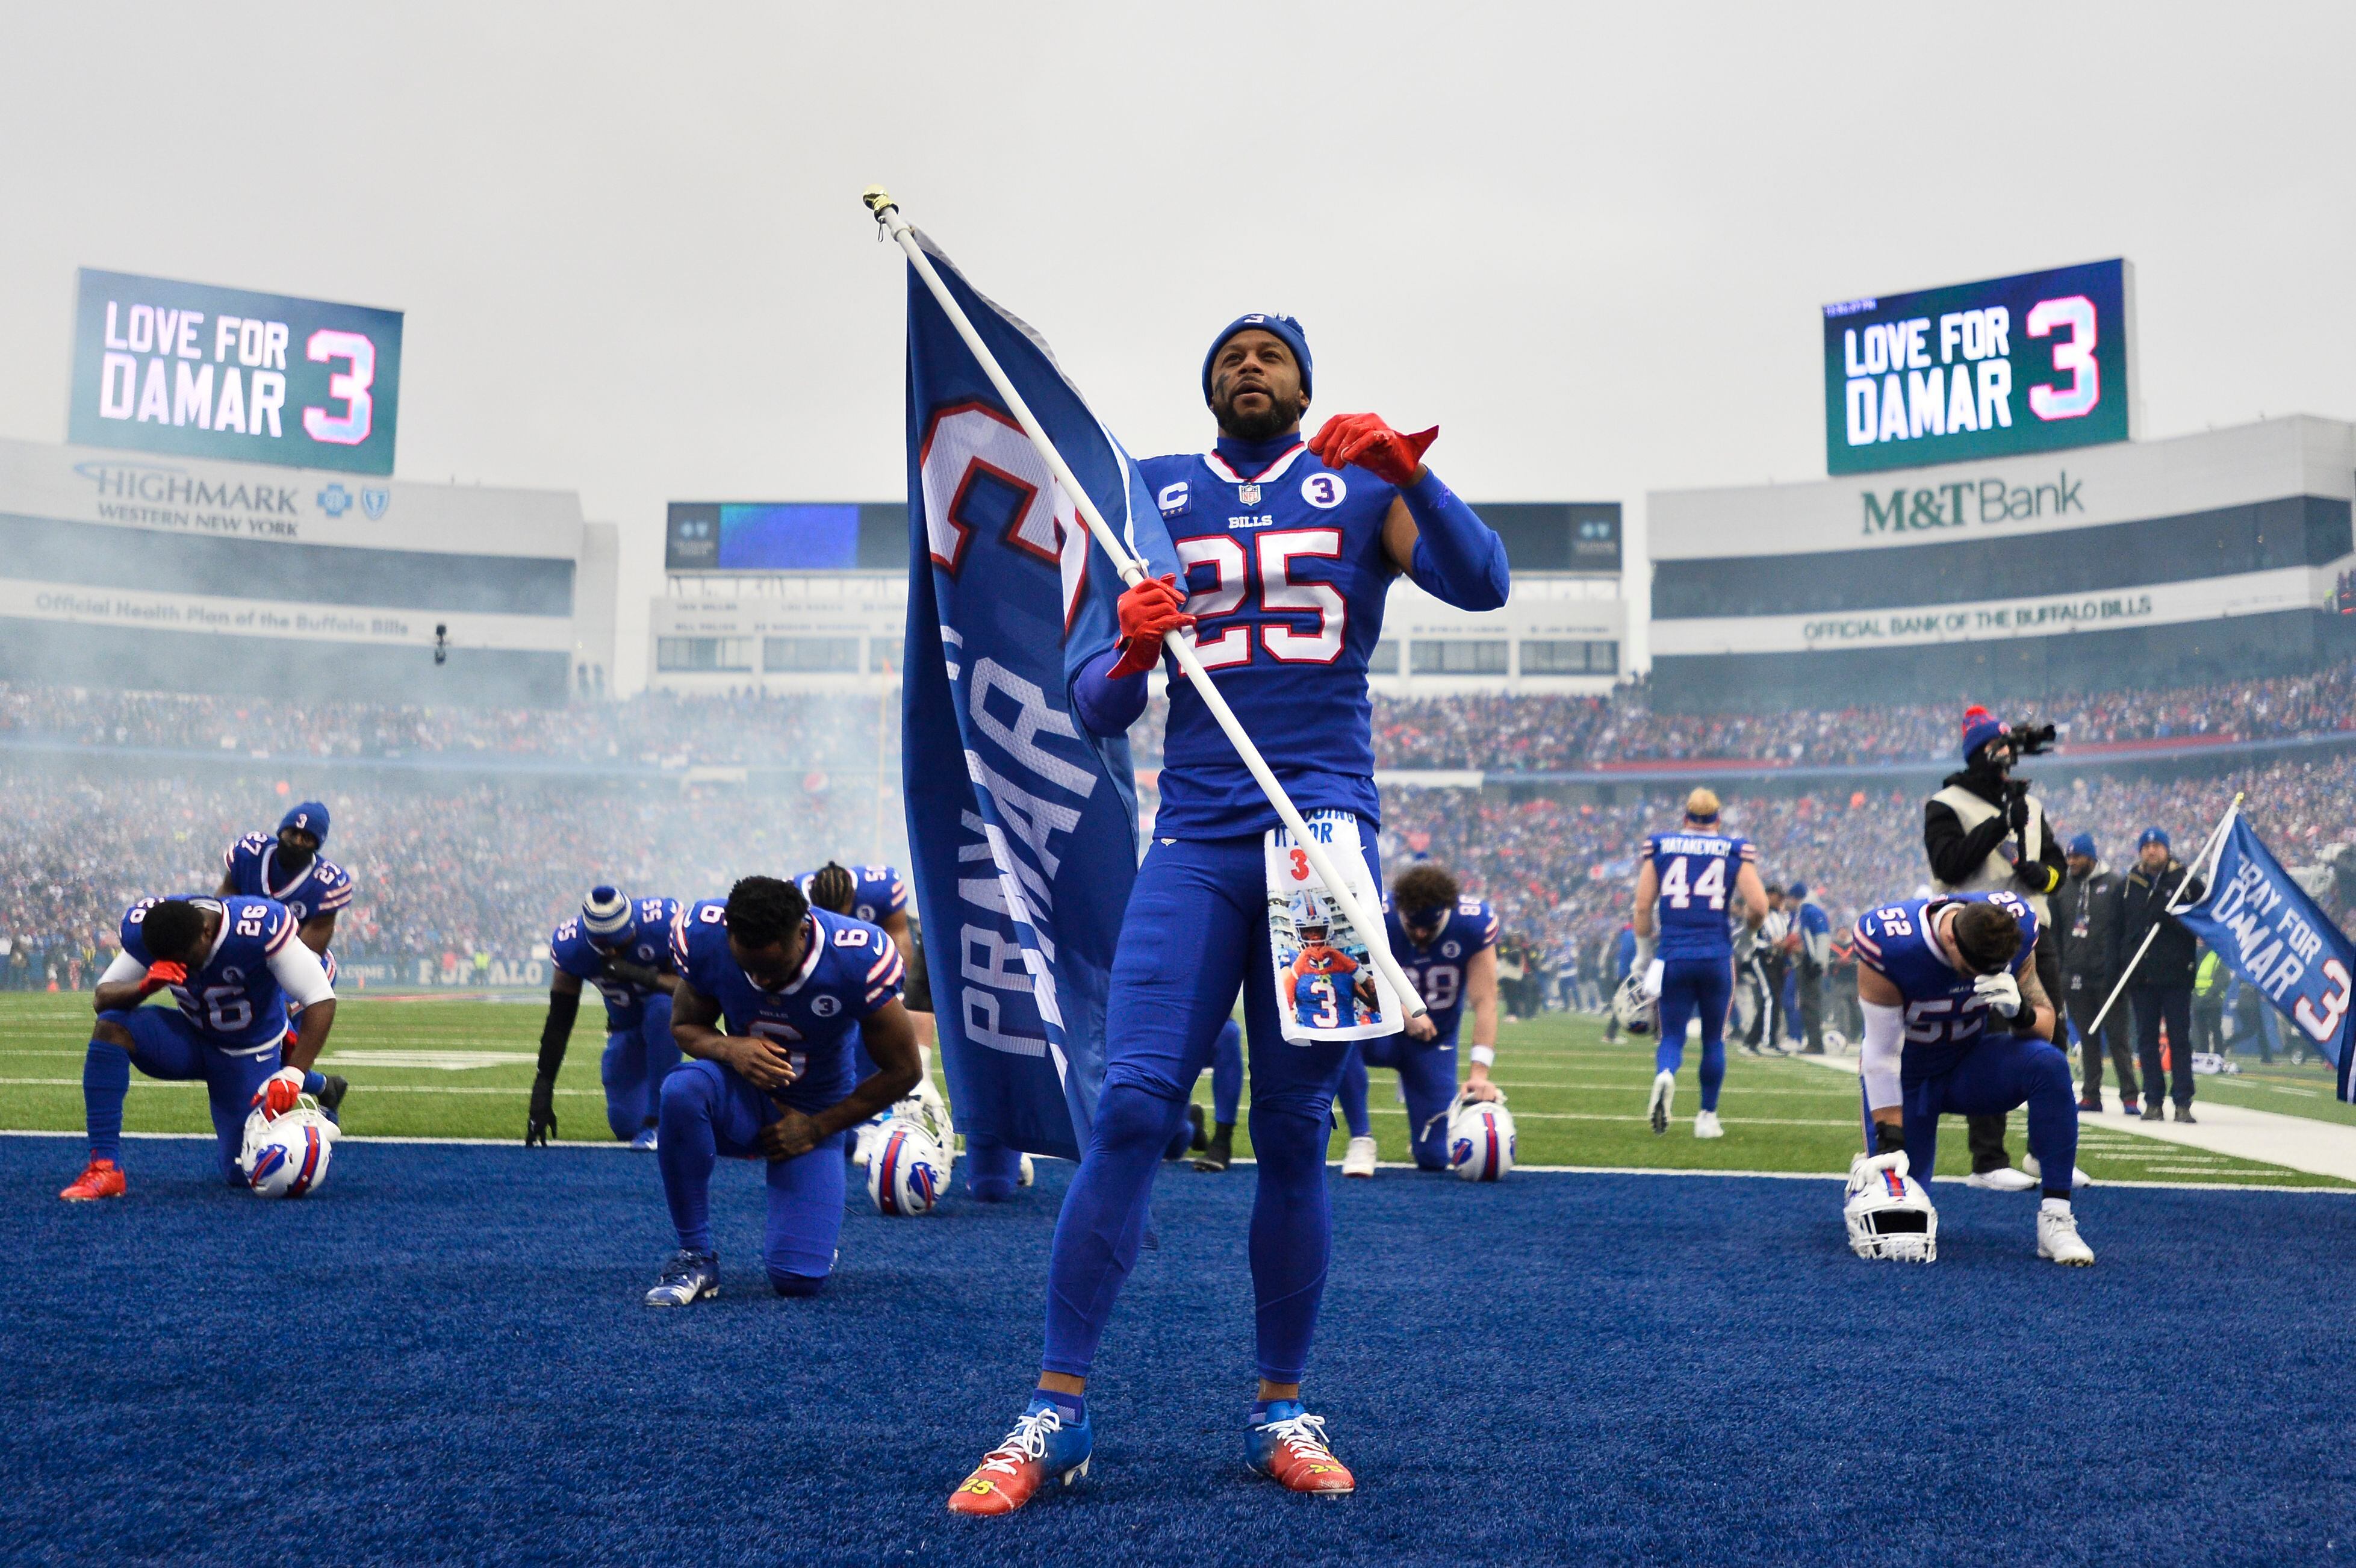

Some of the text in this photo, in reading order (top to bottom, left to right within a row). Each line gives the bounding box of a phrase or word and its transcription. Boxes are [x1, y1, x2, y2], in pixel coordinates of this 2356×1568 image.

[105, 301, 289, 370] LOVE FOR
[1844, 305, 2010, 378] LOVE FOR
[2027, 294, 2100, 421] 3
[99, 352, 286, 438] DAMAR
[303, 328, 375, 446] 3
[1845, 358, 2012, 446] DAMAR
[98, 467, 298, 515] HIGHMARK
[1158, 482, 1188, 510] C
[1243, 493, 1257, 501] NFL
[1311, 478, 1335, 504] 3
[98, 501, 298, 536] WESTERN NEW YORK
[1228, 515, 1273, 529] BILLS
[1174, 527, 1347, 678] 25
[1891, 615, 1941, 636] BANK
[1945, 613, 1968, 630] OF
[1975, 609, 2010, 629] THE
[296, 814, 308, 829] 3
[1294, 822, 1332, 846] OR
[241, 831, 269, 856] 27
[313, 860, 341, 885] 27
[1290, 849, 1310, 881] 3
[1661, 855, 1726, 910] 44
[236, 905, 268, 936] 26
[642, 899, 662, 924] 55
[1877, 906, 1913, 937] 52
[834, 928, 869, 947] 6
[2277, 907, 2322, 964] FOR
[818, 998, 834, 1015] 3
[1310, 981, 1339, 1028] 3
[2293, 959, 2351, 1042] 3
[957, 1478, 995, 1495] 25
